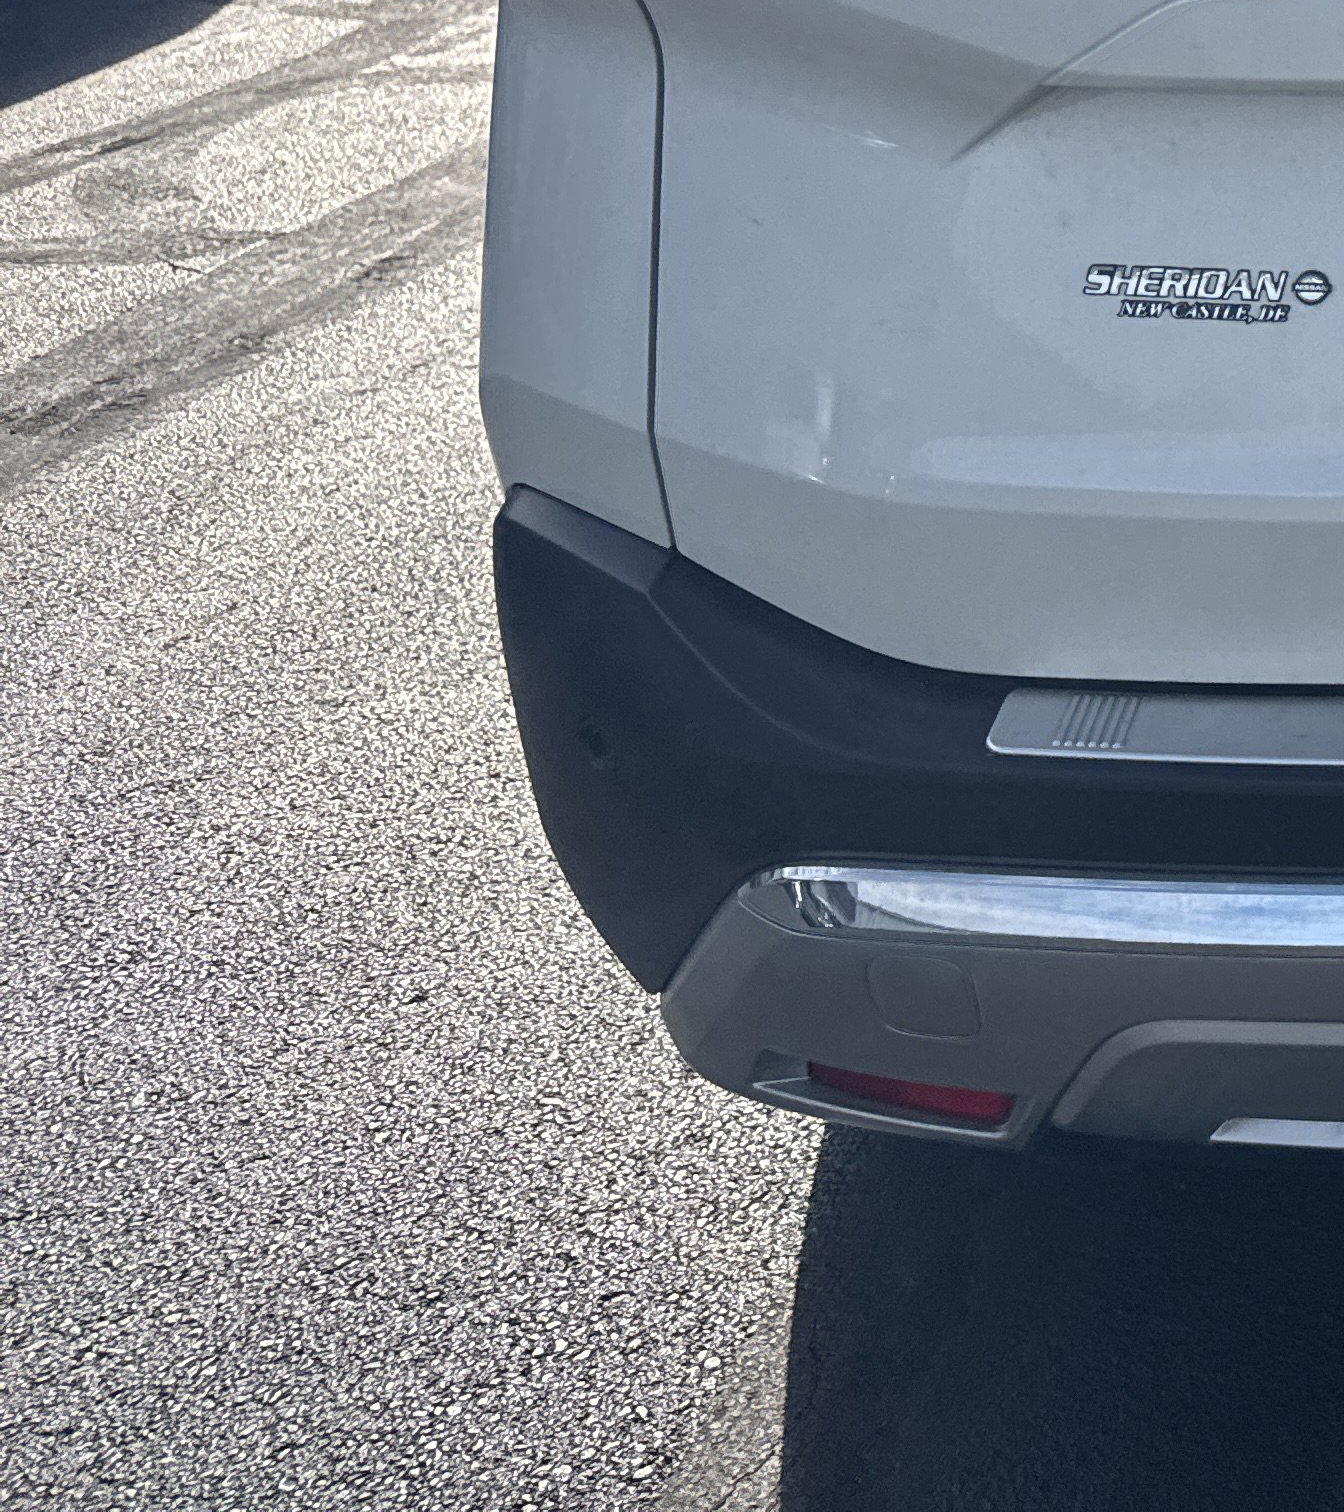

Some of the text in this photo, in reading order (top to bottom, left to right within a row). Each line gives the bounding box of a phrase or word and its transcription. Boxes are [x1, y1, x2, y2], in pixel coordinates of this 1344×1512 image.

[1083, 263, 1289, 302] SHERIDAN
[1117, 299, 1291, 324] NEW CASTLE, DE
